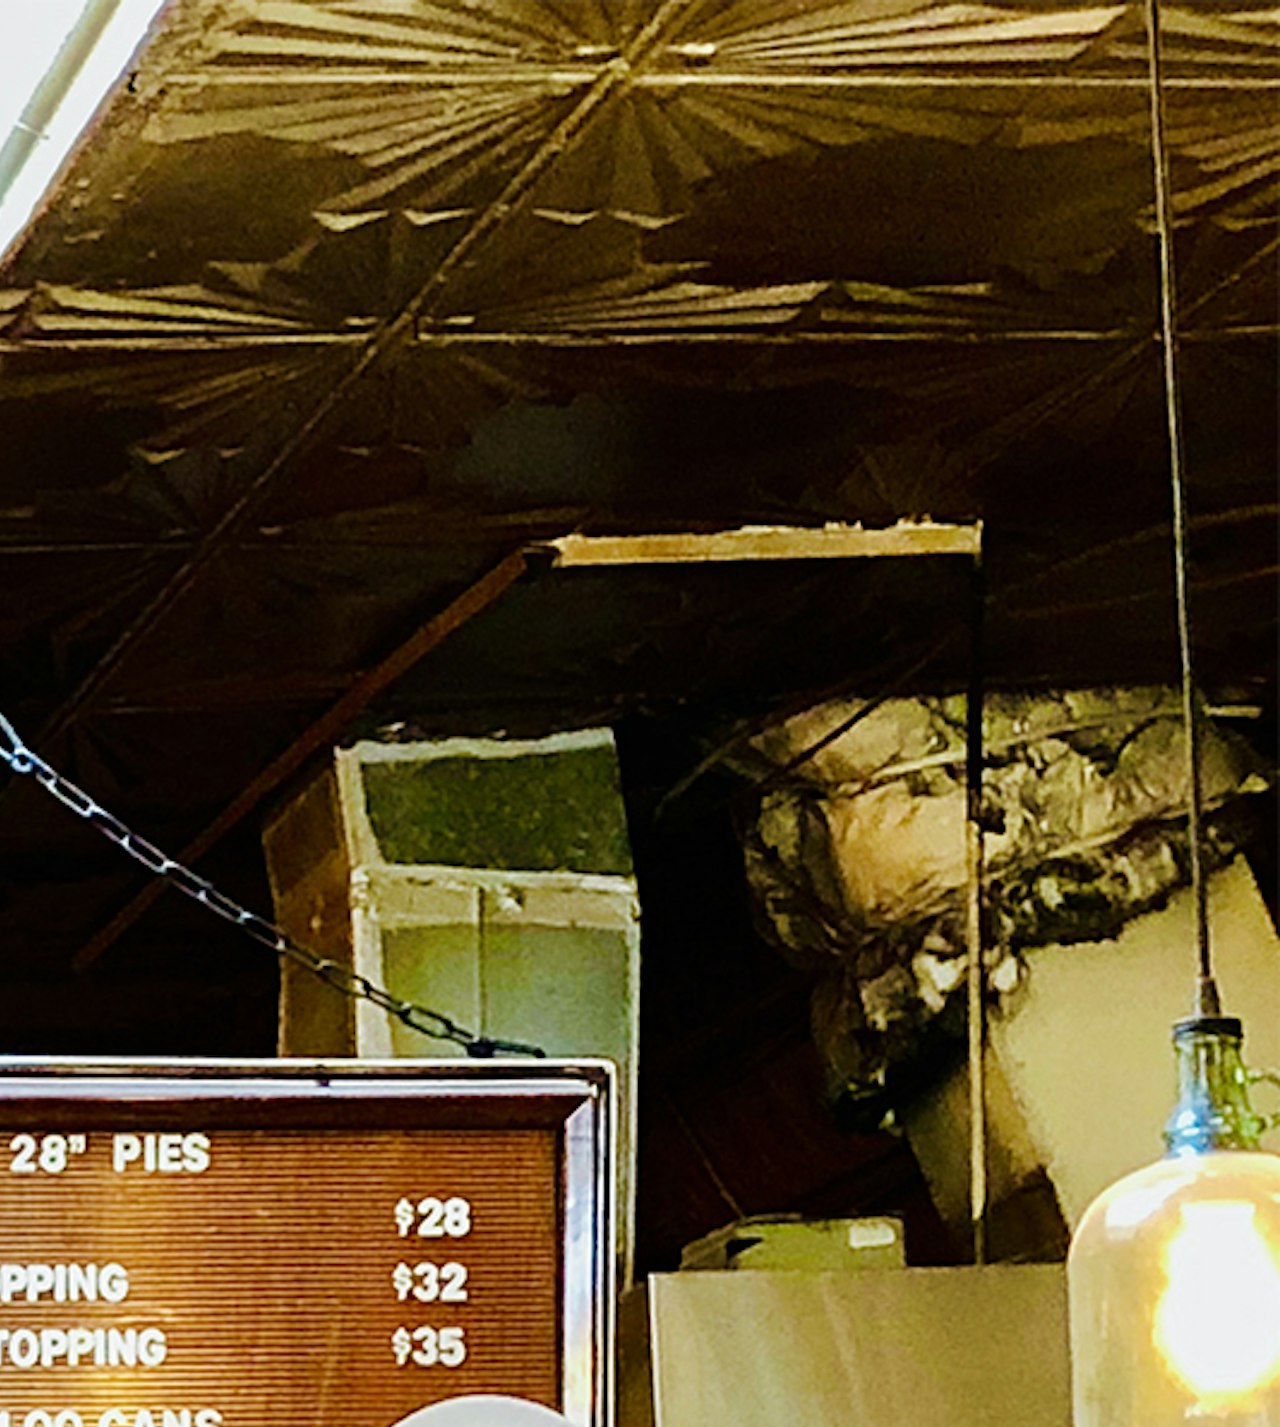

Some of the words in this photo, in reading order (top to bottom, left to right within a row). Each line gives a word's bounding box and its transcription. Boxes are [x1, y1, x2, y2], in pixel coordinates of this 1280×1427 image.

[114, 1134, 209, 1172] PIES
[395, 1198, 470, 1236] $28
[393, 1263, 467, 1301] $32
[393, 1327, 465, 1365] $35
